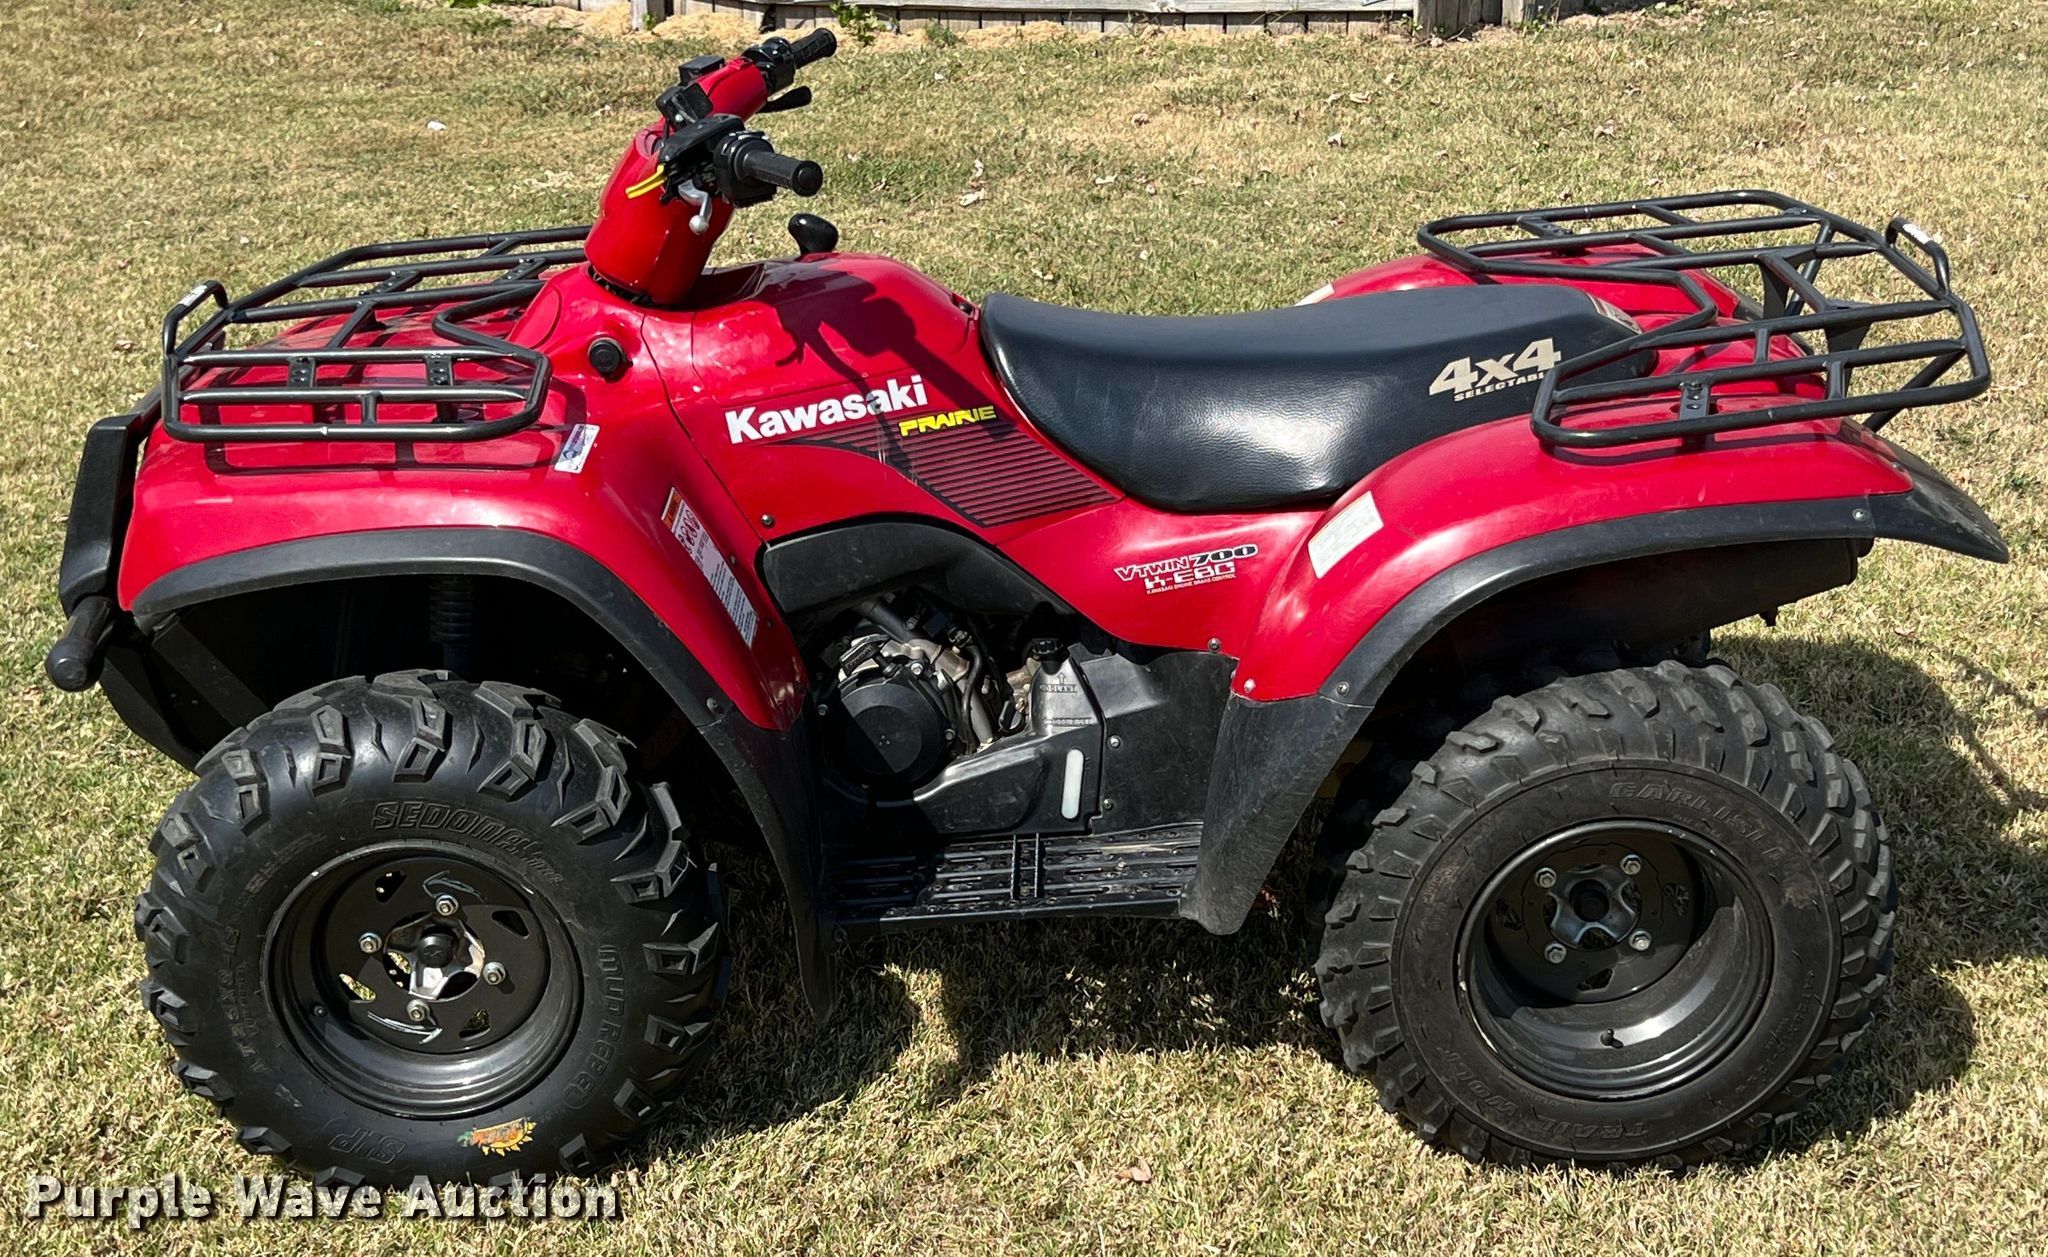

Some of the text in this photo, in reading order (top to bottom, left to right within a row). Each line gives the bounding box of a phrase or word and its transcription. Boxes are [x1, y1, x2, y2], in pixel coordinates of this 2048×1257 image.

[1429, 338, 1561, 396] 4x4
[1454, 371, 1545, 402] SELECTABL
[724, 374, 928, 444] Kawasaki
[899, 405, 997, 437] PRAIRIE
[1190, 544, 1258, 567] 700
[1144, 562, 1236, 589] K-EBC
[371, 801, 530, 856] SEDONA
